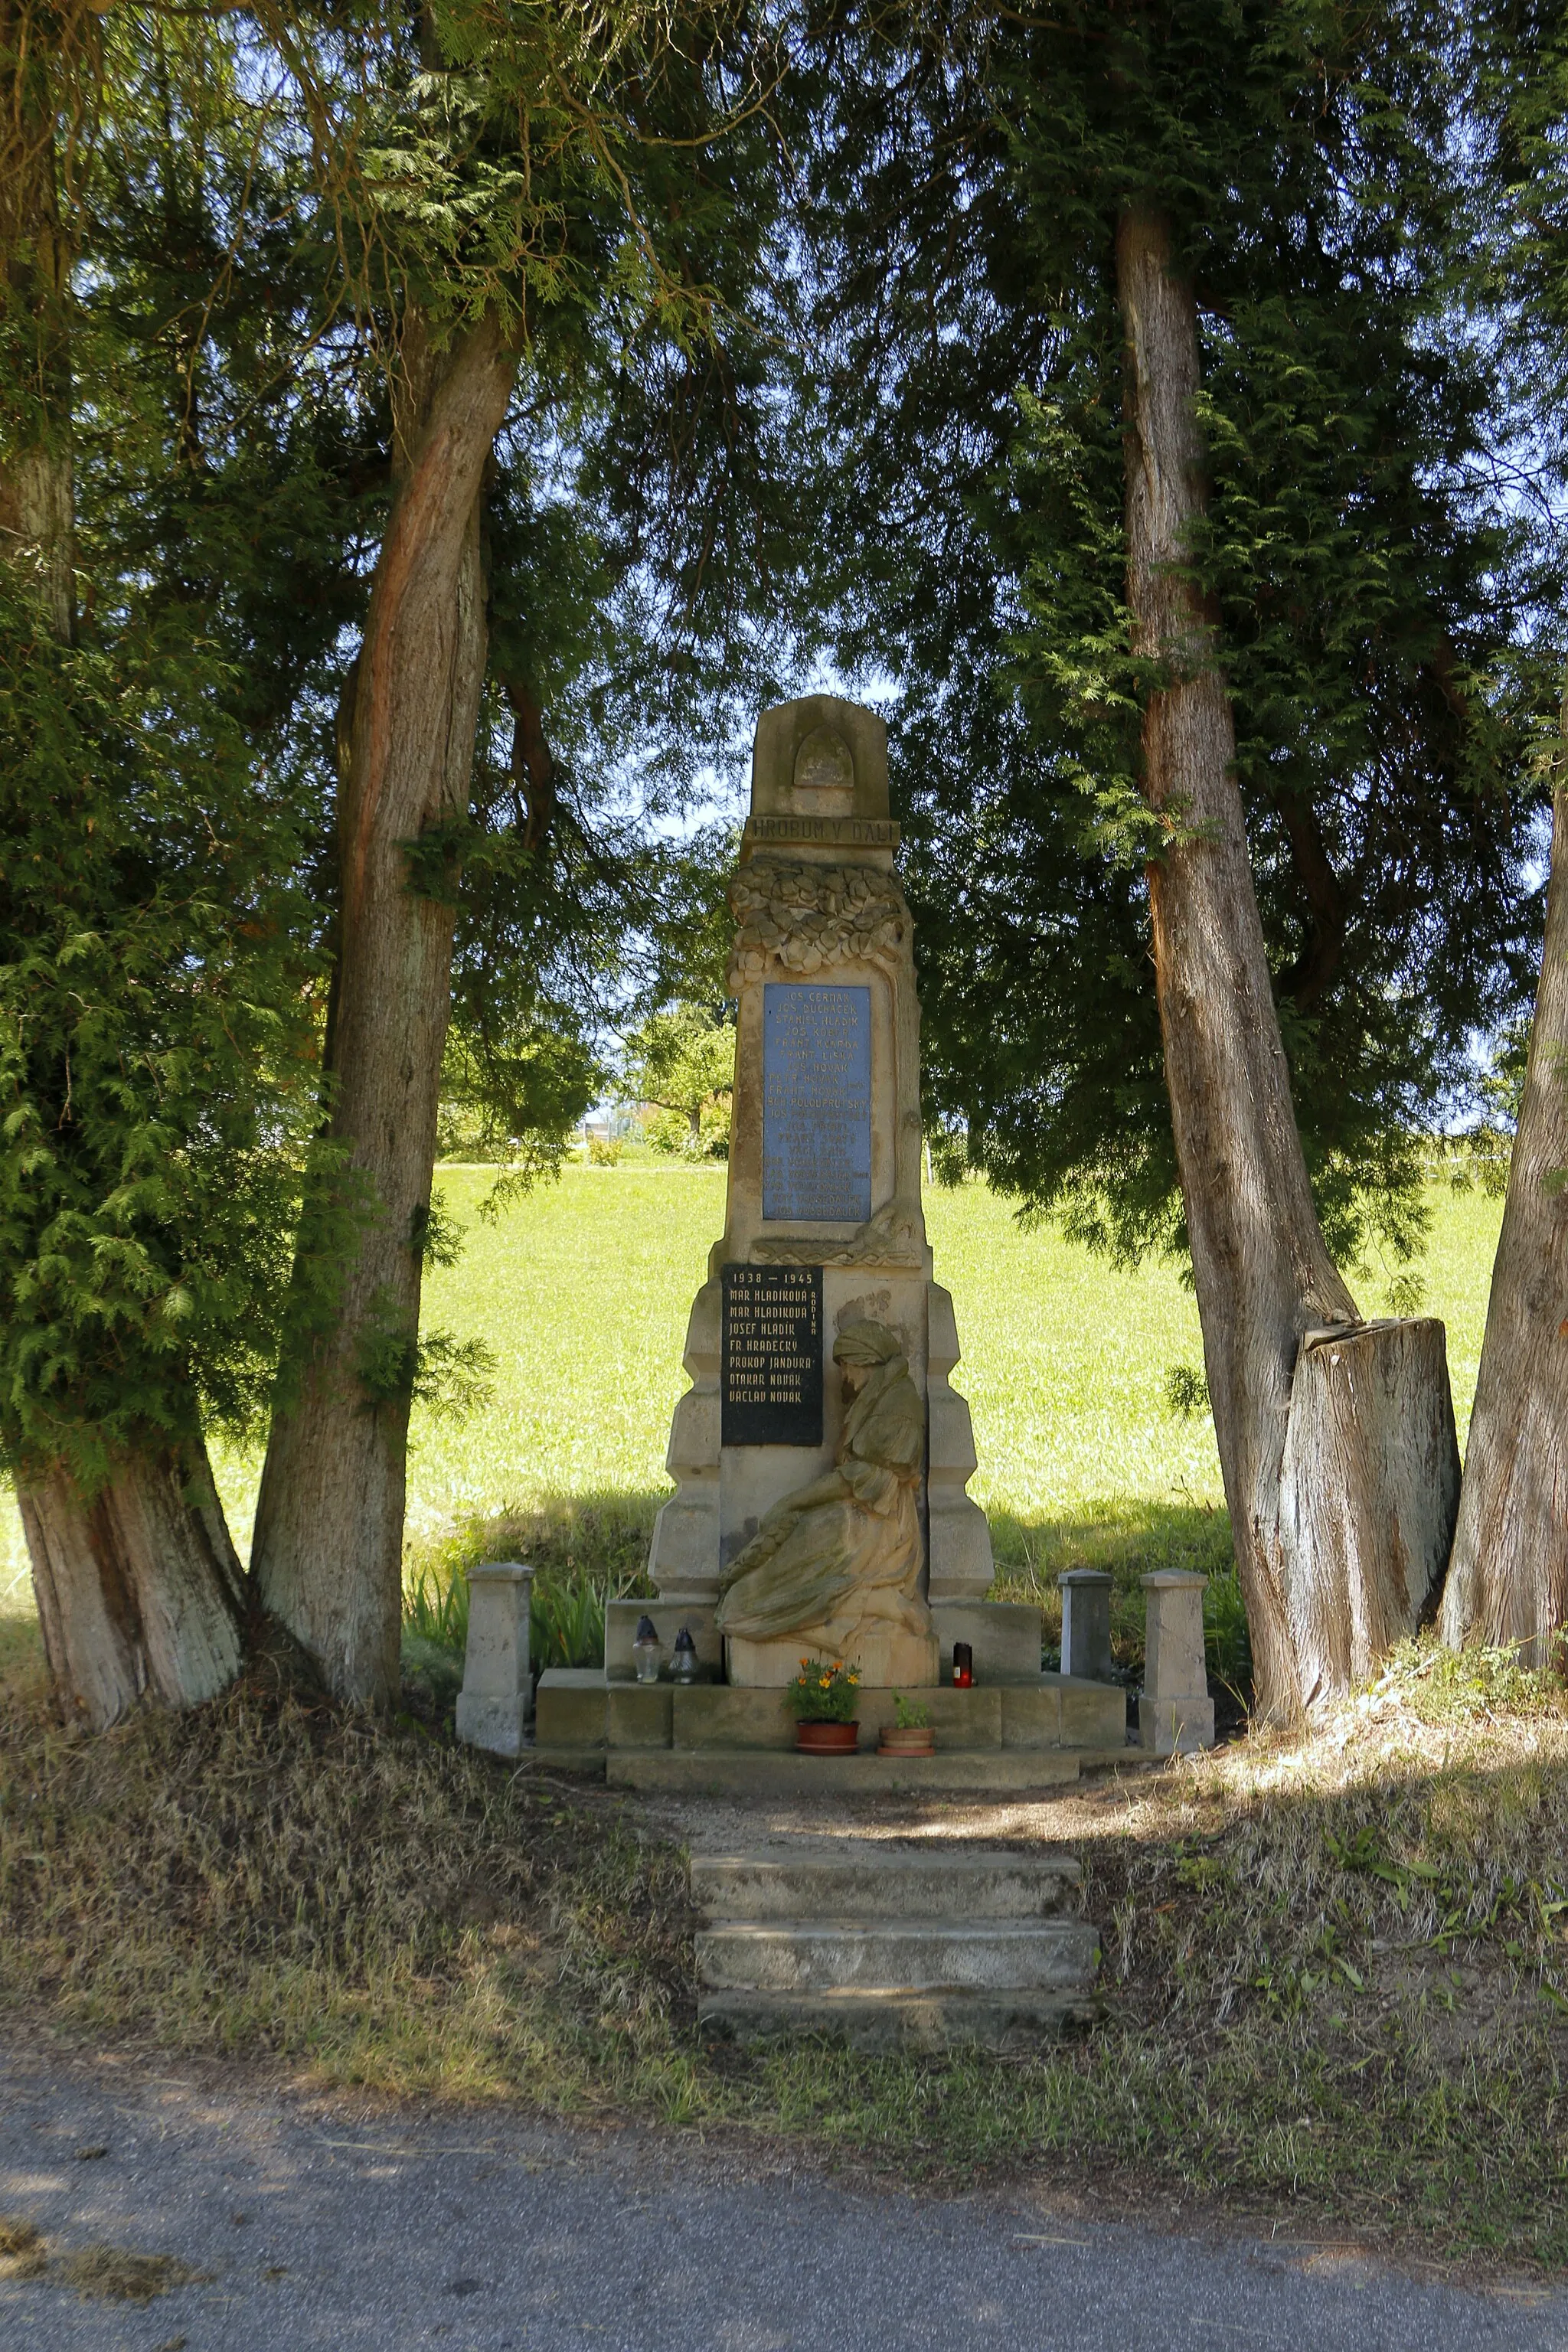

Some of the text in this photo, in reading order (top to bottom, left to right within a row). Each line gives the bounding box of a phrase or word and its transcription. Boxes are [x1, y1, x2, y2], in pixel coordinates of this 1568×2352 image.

[832, 822, 841, 840] V
[733, 1273, 761, 1283] 1938
[784, 1274, 812, 1284] 1945
[729, 1323, 756, 1336] JOSEF
[730, 1357, 811, 1370] PROKOP JANDURA
[730, 1374, 765, 1385] OTAKAR
